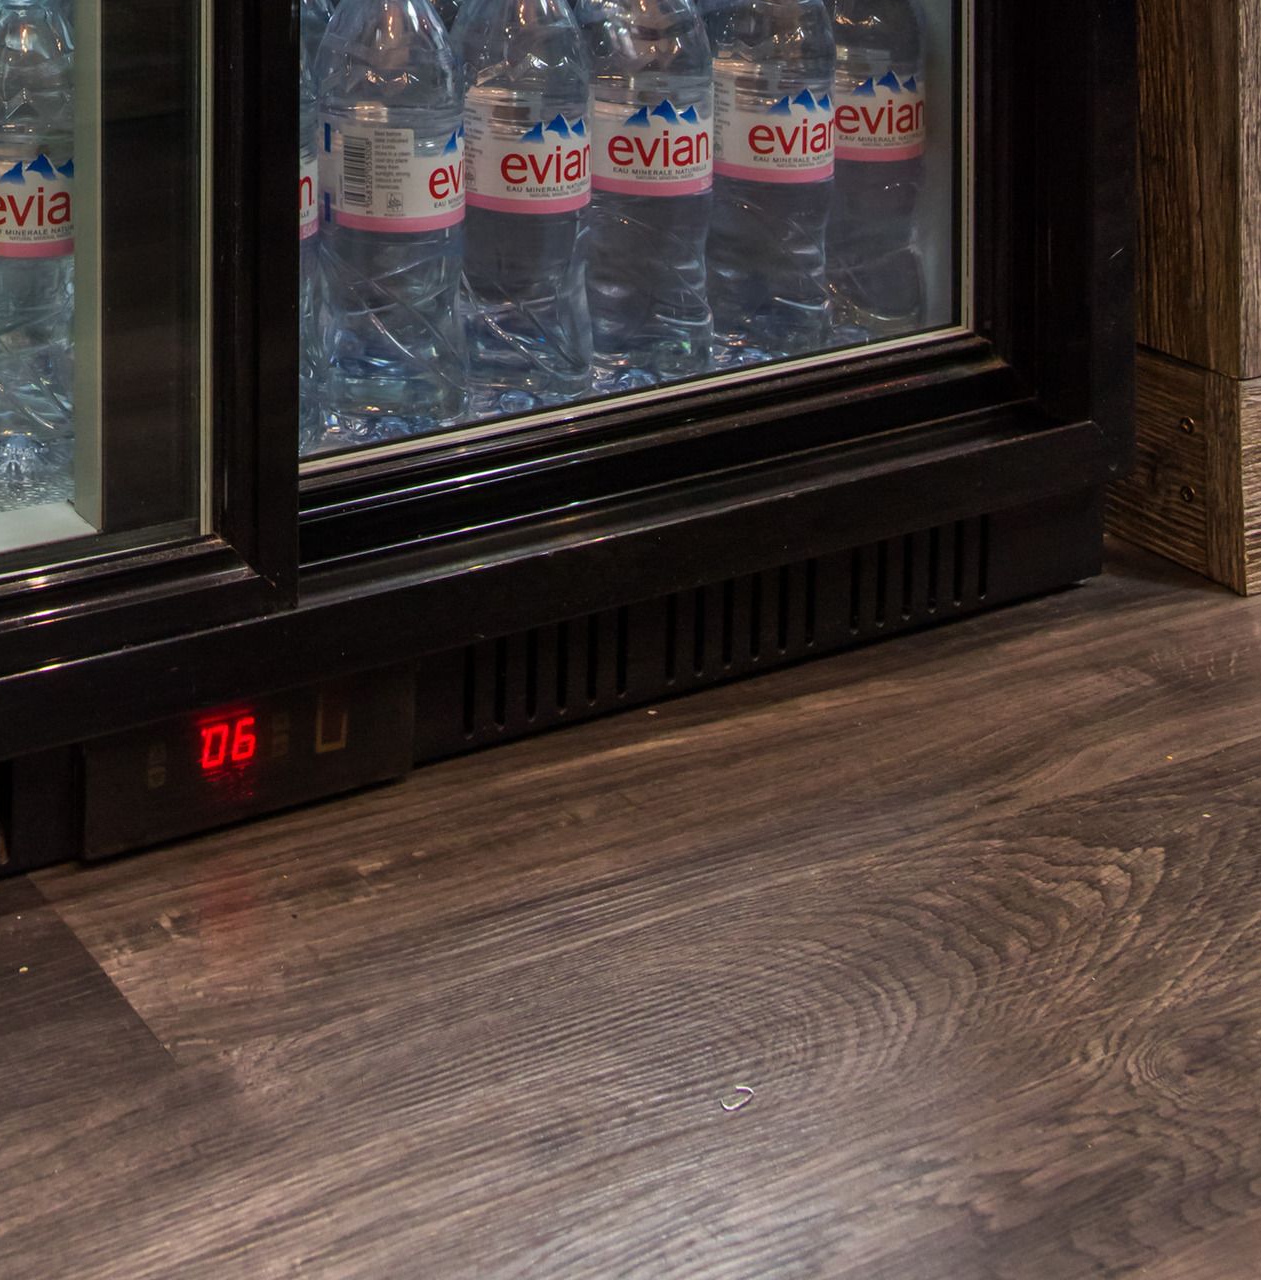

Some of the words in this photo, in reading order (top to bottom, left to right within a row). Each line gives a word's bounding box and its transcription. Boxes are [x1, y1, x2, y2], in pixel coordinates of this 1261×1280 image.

[607, 130, 709, 168] evian
[613, 167, 629, 175] EAU
[632, 168, 672, 176] MINERALE
[506, 185, 523, 193] EAU
[526, 185, 564, 193] MINERALE
[5, 228, 48, 236] MINERALE
[201, 716, 256, 770] 06
